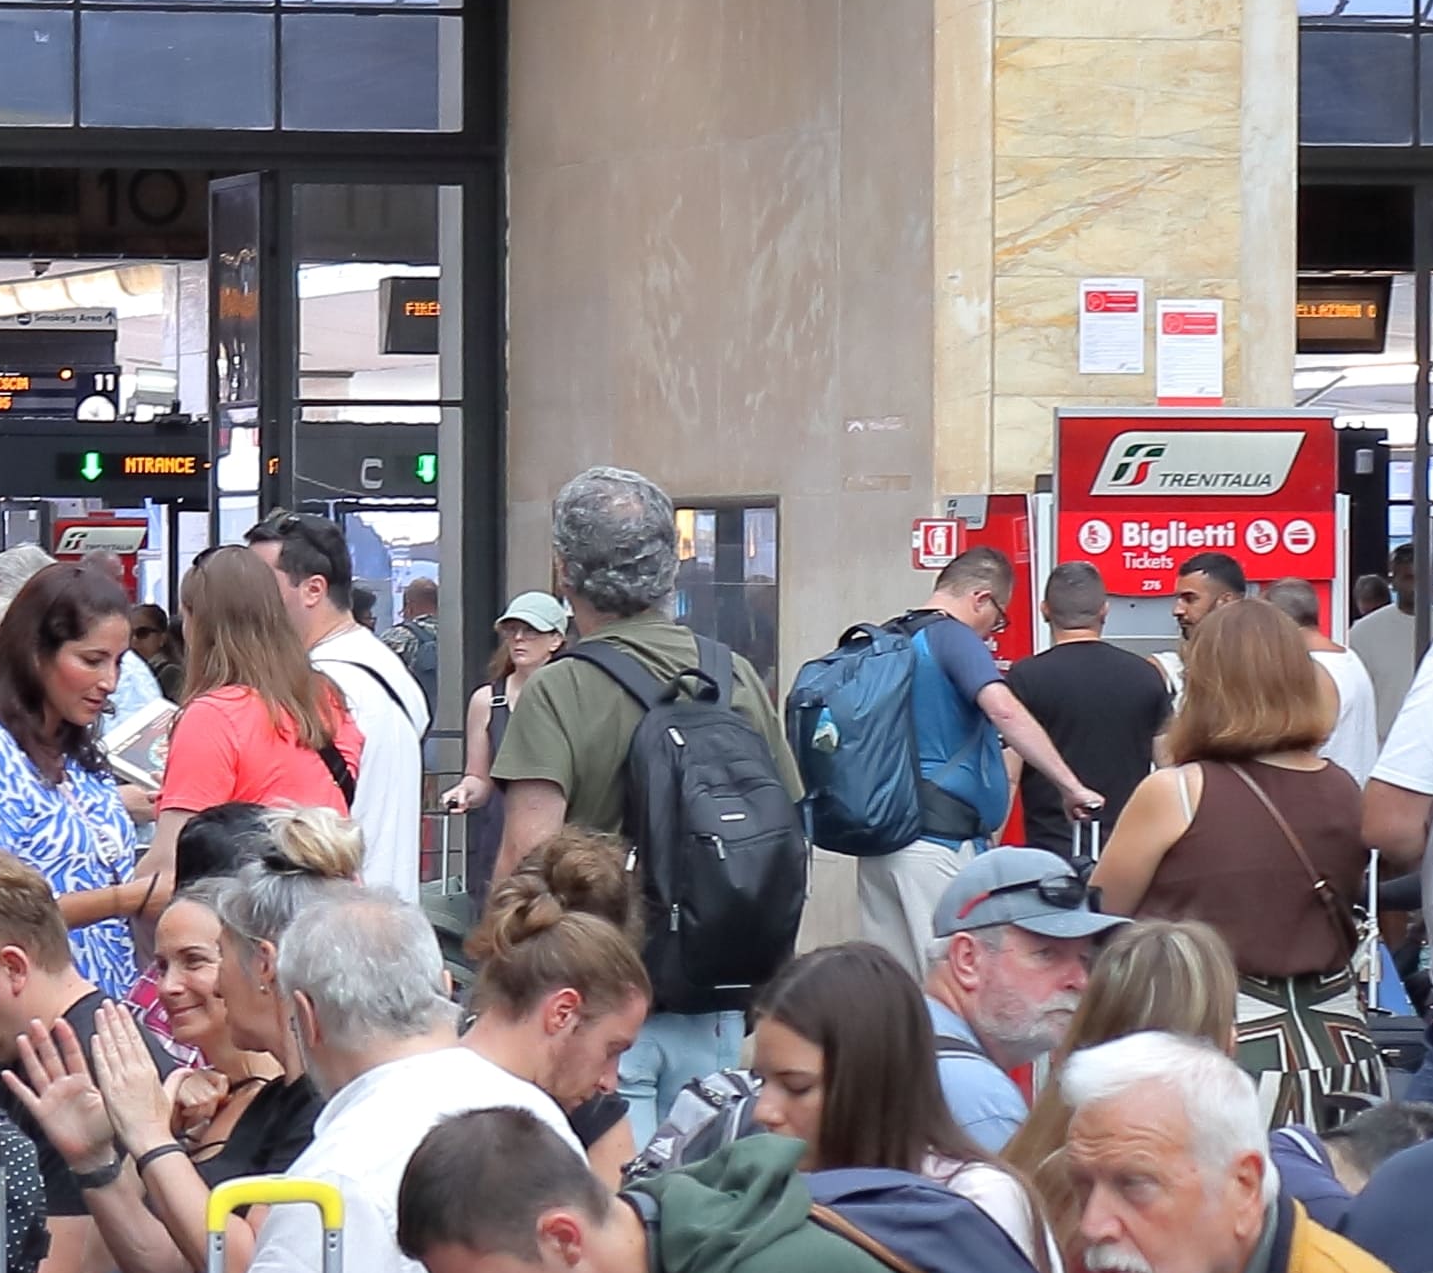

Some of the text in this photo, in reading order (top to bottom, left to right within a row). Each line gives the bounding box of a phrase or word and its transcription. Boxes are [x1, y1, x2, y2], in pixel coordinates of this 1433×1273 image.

[94, 373, 115, 392] 11
[1158, 472, 1273, 489] TRENITALIA
[1121, 521, 1235, 555] Biglietti
[1122, 553, 1174, 570] Tickets
